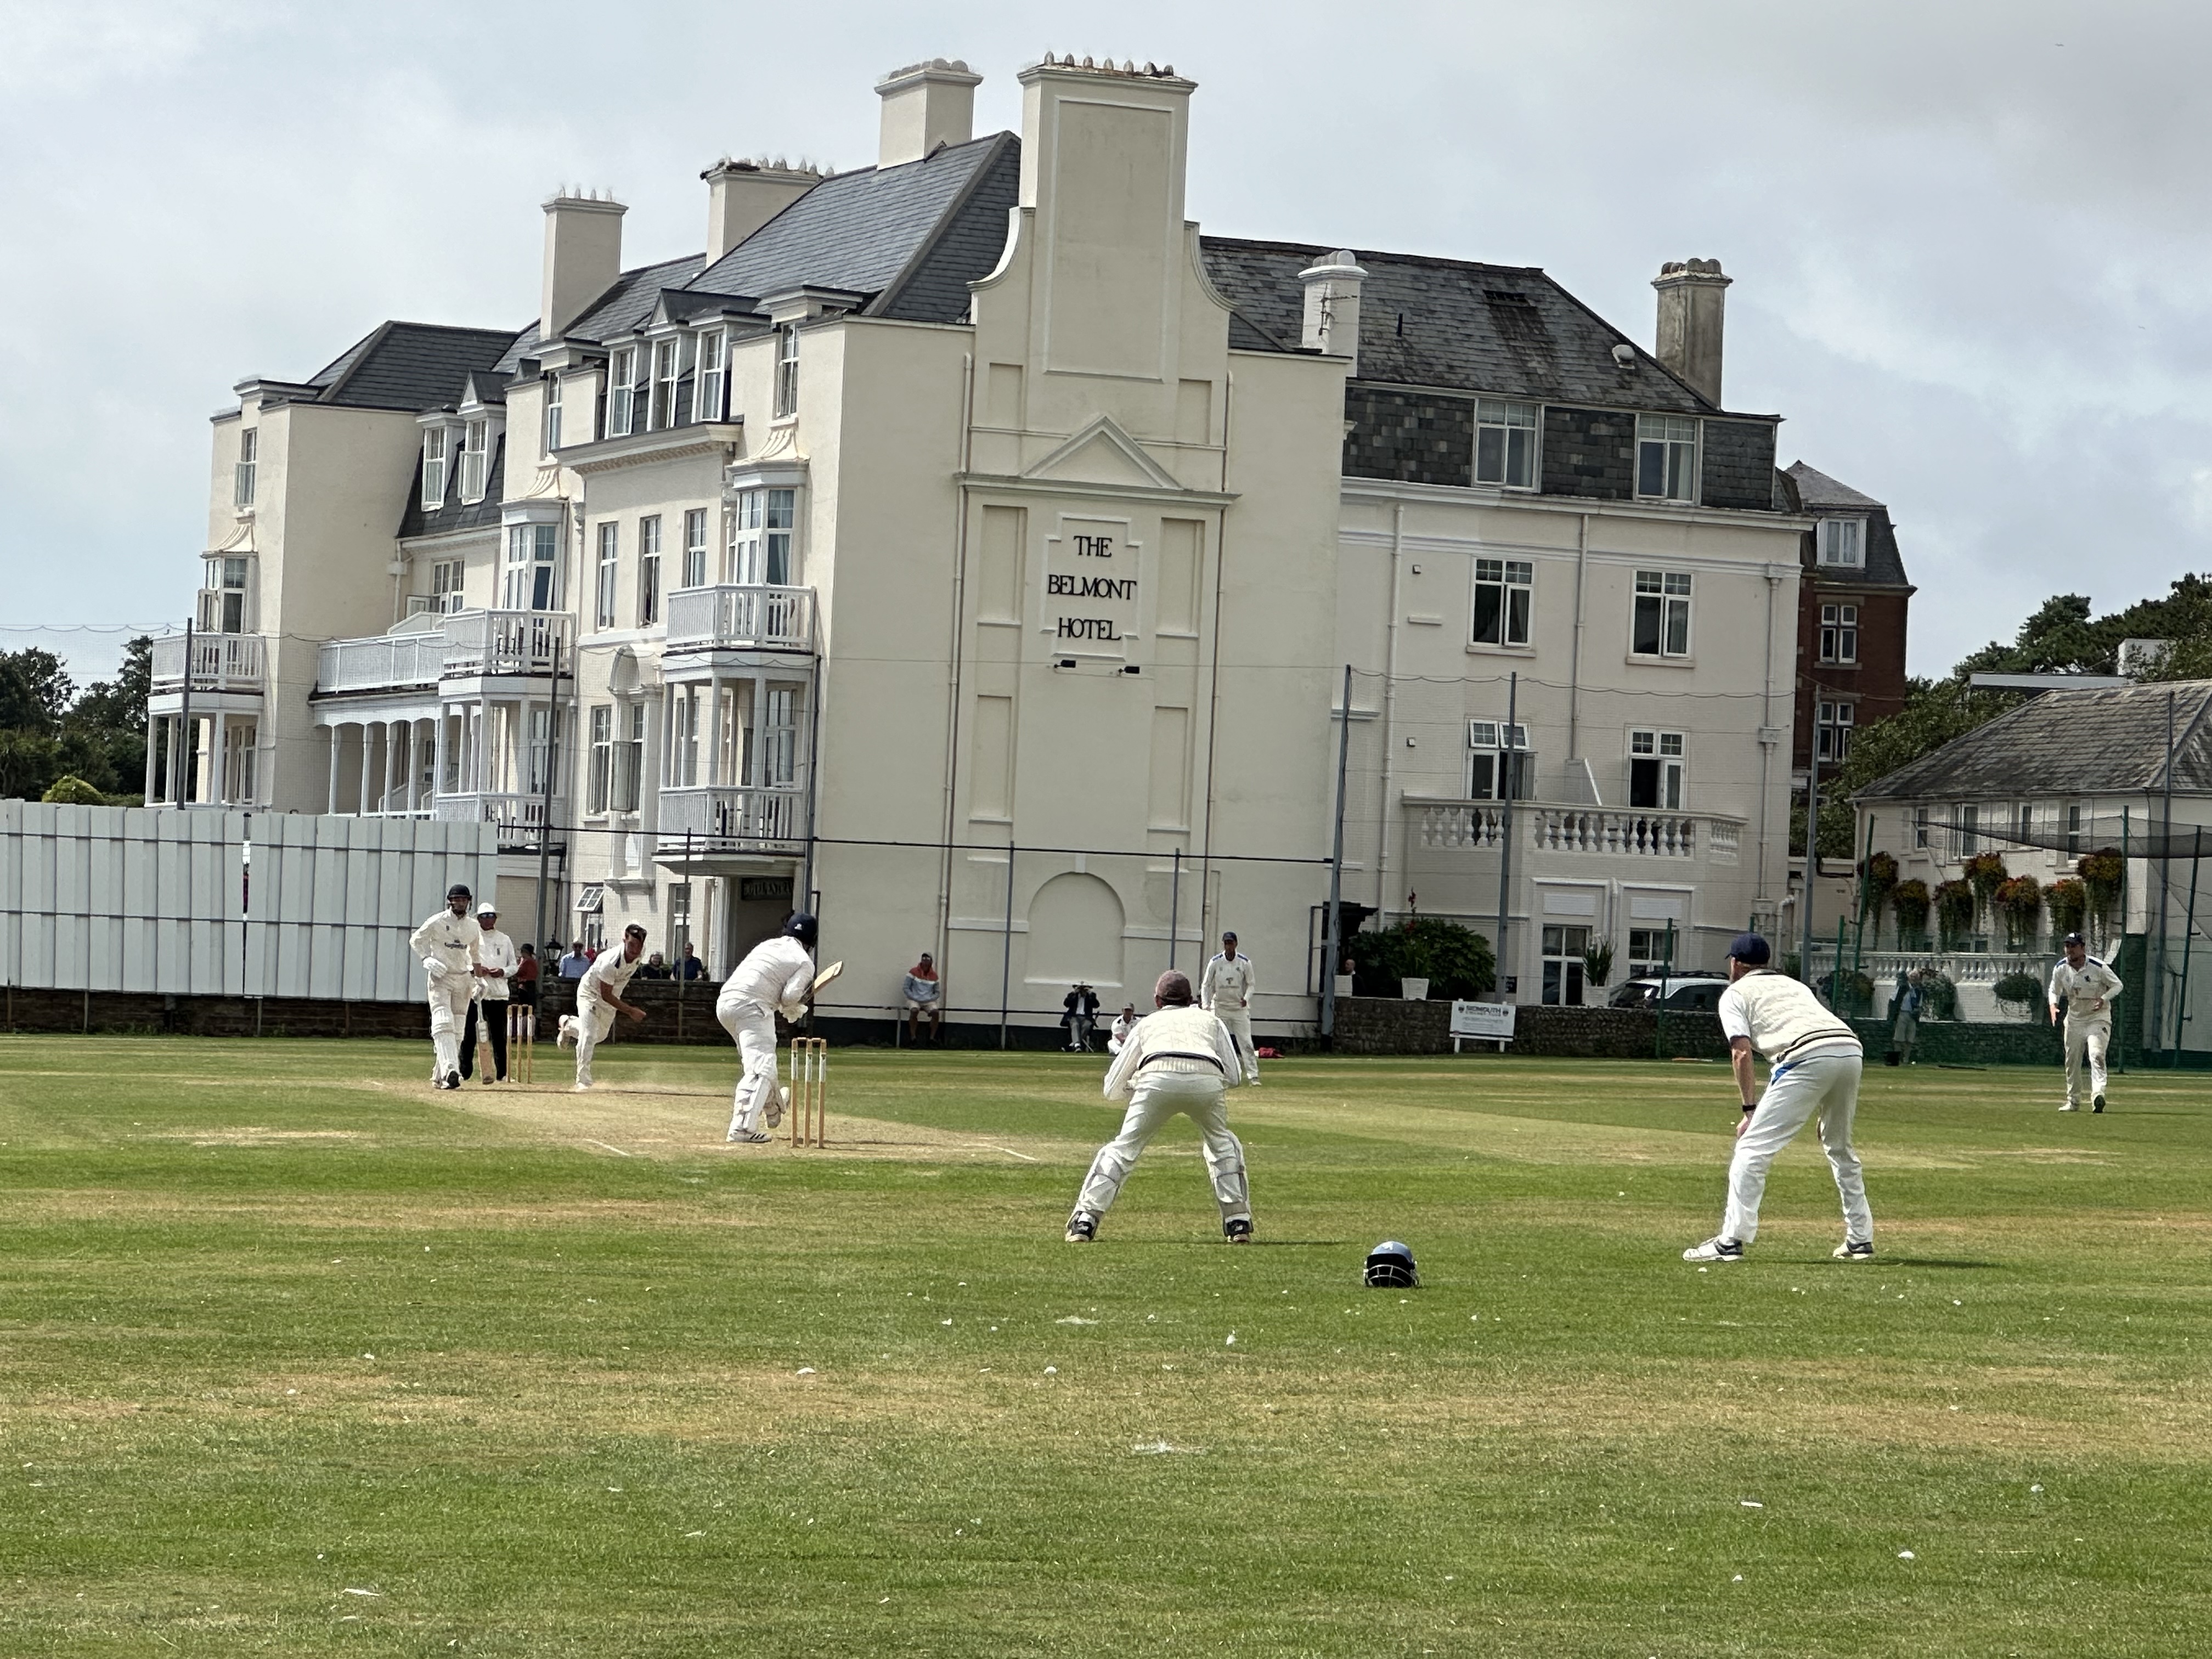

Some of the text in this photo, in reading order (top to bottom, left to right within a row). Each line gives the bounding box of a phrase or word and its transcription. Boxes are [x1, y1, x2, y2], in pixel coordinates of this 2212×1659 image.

[1073, 535, 1112, 557] THE
[1048, 574, 1137, 600] BELMONT
[1057, 617, 1121, 641] HOTEL
